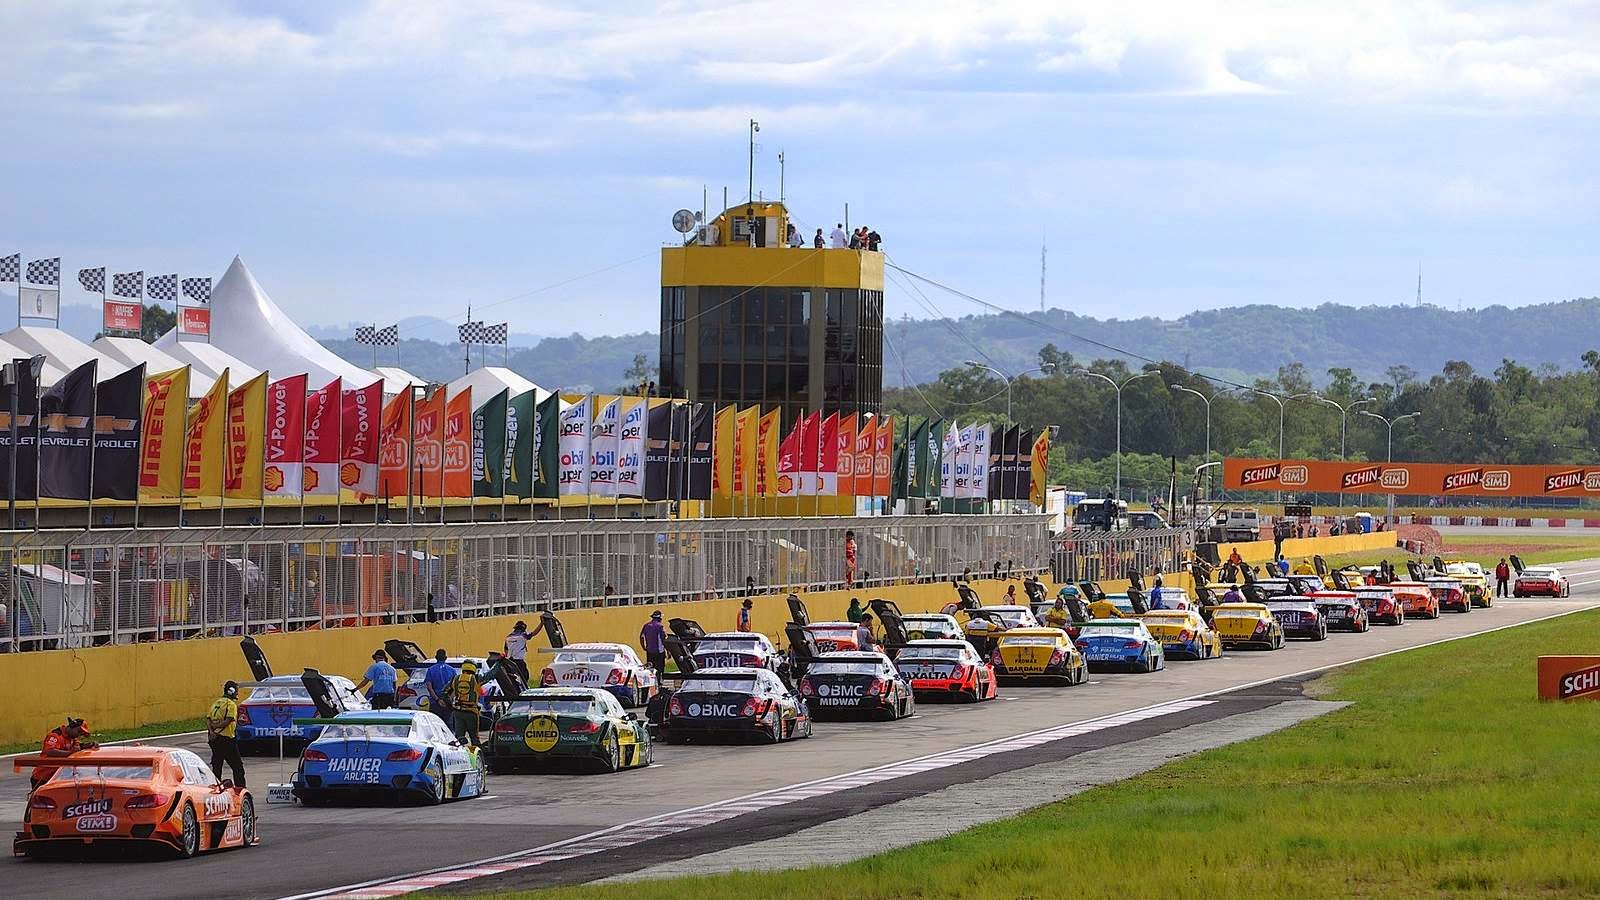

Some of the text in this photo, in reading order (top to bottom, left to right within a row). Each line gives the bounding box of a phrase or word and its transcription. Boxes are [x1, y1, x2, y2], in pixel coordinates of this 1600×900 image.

[270, 383, 286, 461] V-Power
[304, 389, 327, 461] V-Power
[350, 390, 369, 458] V-Power
[1244, 467, 1277, 482] SCHIN
[1282, 468, 1305, 482] SIM!
[1344, 470, 1378, 486] SCHIN
[1383, 471, 1406, 485] SIM!
[1446, 472, 1479, 488] SCHIN
[1485, 473, 1507, 487] SIM!
[1547, 473, 1581, 489] SCHIN
[1185, 531, 1192, 546] 3
[704, 653, 742, 669] prati
[1564, 670, 1599, 694] SCHI
[830, 685, 864, 697] BMC
[819, 697, 861, 706] MIDWAY
[702, 704, 738, 717] BMC
[526, 730, 558, 739] CIMED
[328, 757, 382, 772] HANIER
[343, 771, 380, 784] ARLA 32
[66, 801, 108, 818] SCHIN
[80, 817, 112, 829] SIM!
